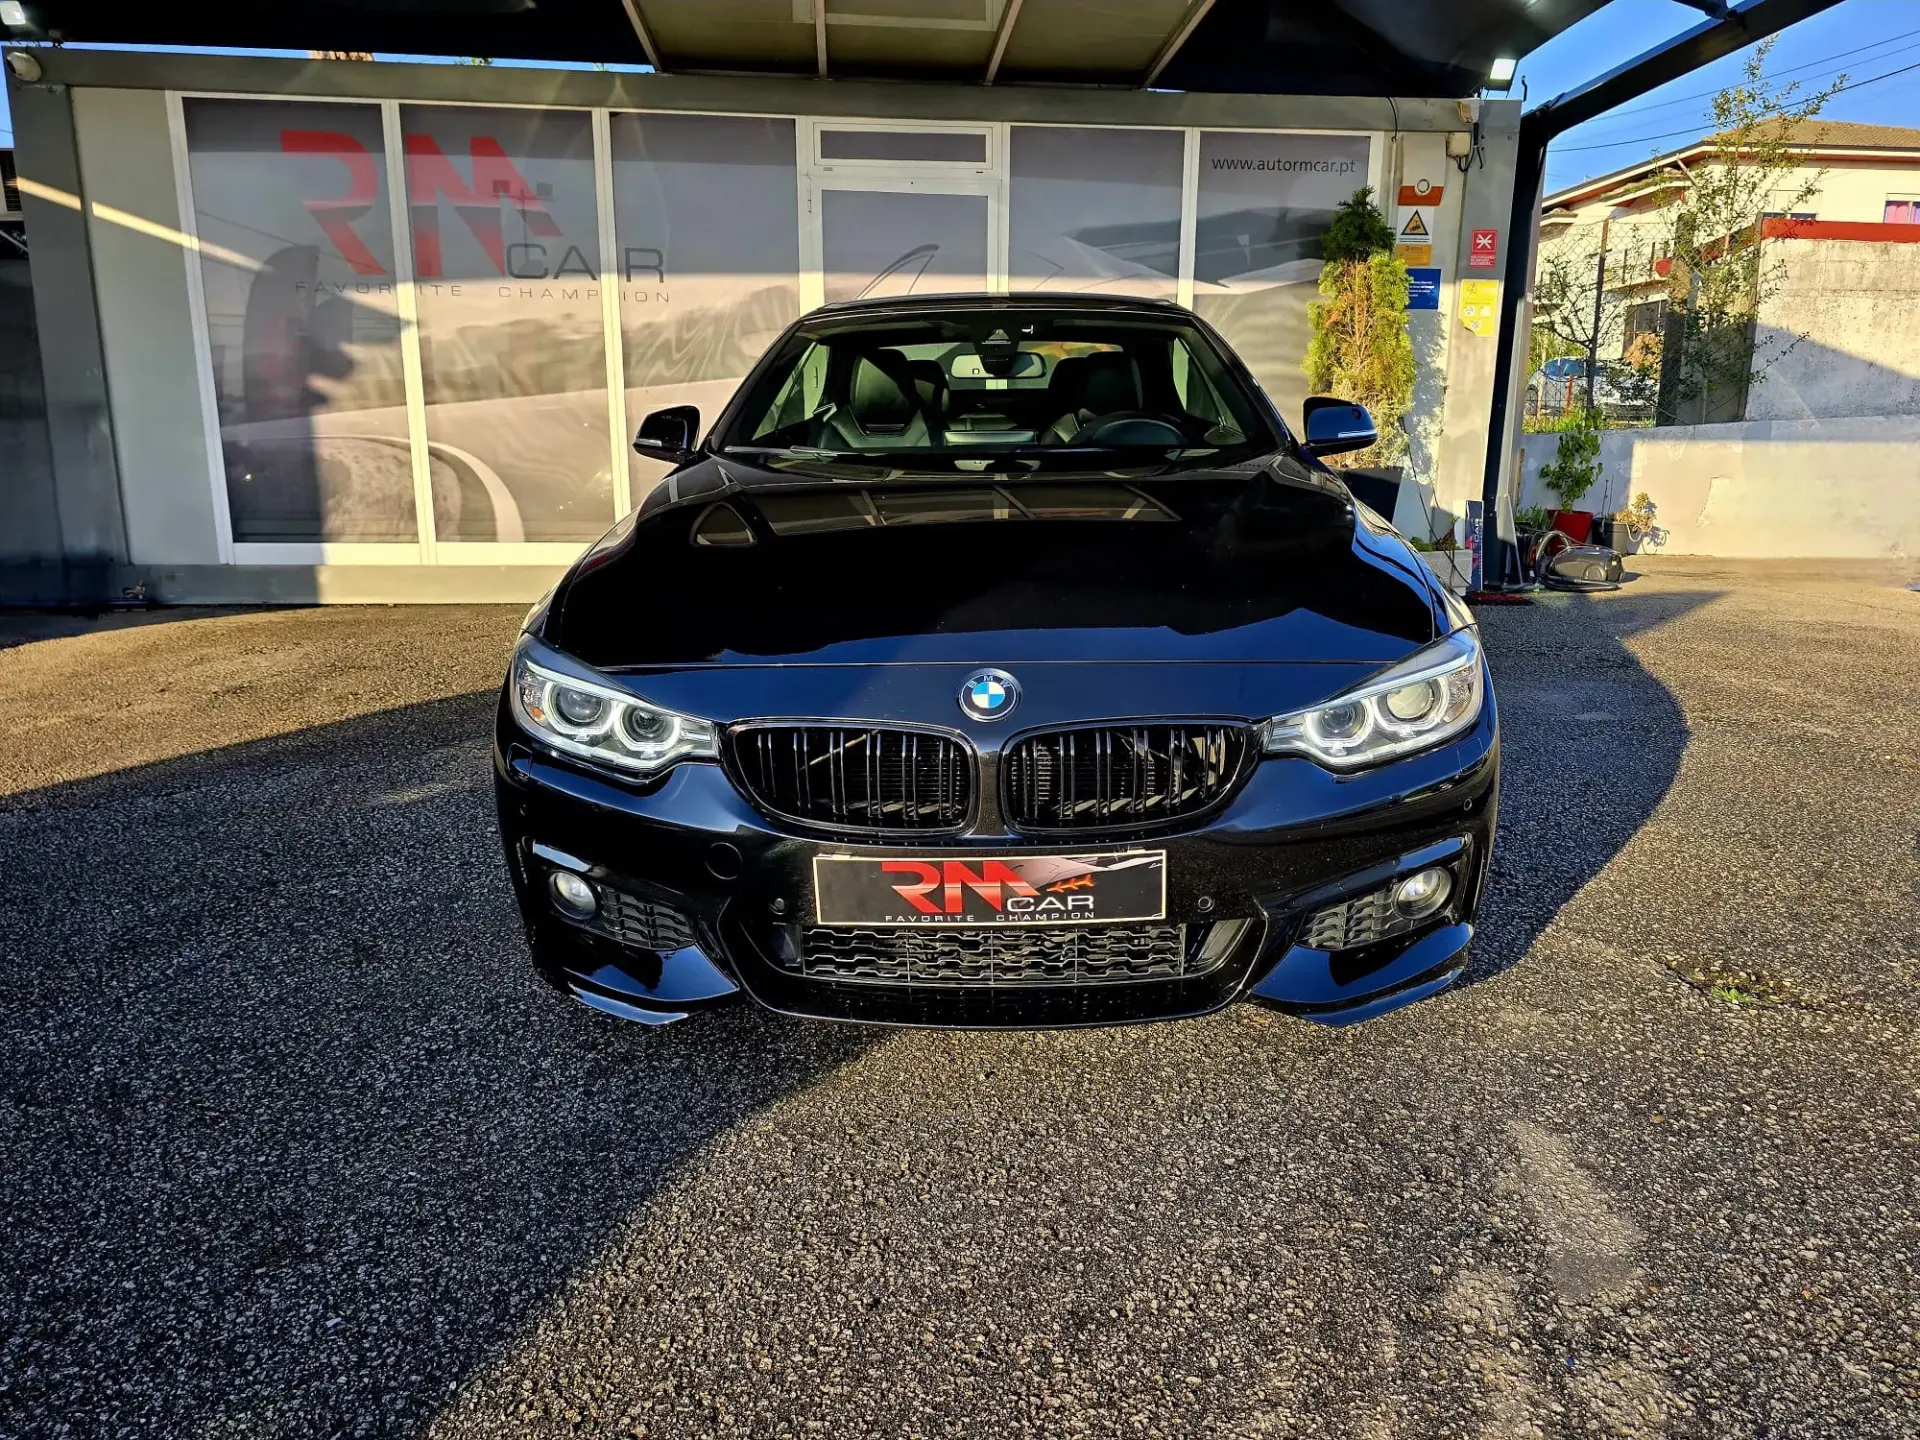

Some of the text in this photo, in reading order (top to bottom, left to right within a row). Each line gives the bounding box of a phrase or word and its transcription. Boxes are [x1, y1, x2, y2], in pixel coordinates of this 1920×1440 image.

[1211, 157, 1356, 176] www.autormcar.pt
[506, 243, 665, 283] CAR
[295, 281, 670, 303] FAVORITE CHAMPION
[968, 675, 1010, 689] BMW
[881, 861, 1095, 913] RM CAR
[885, 912, 1095, 923] FAVORITE CHAMPION
